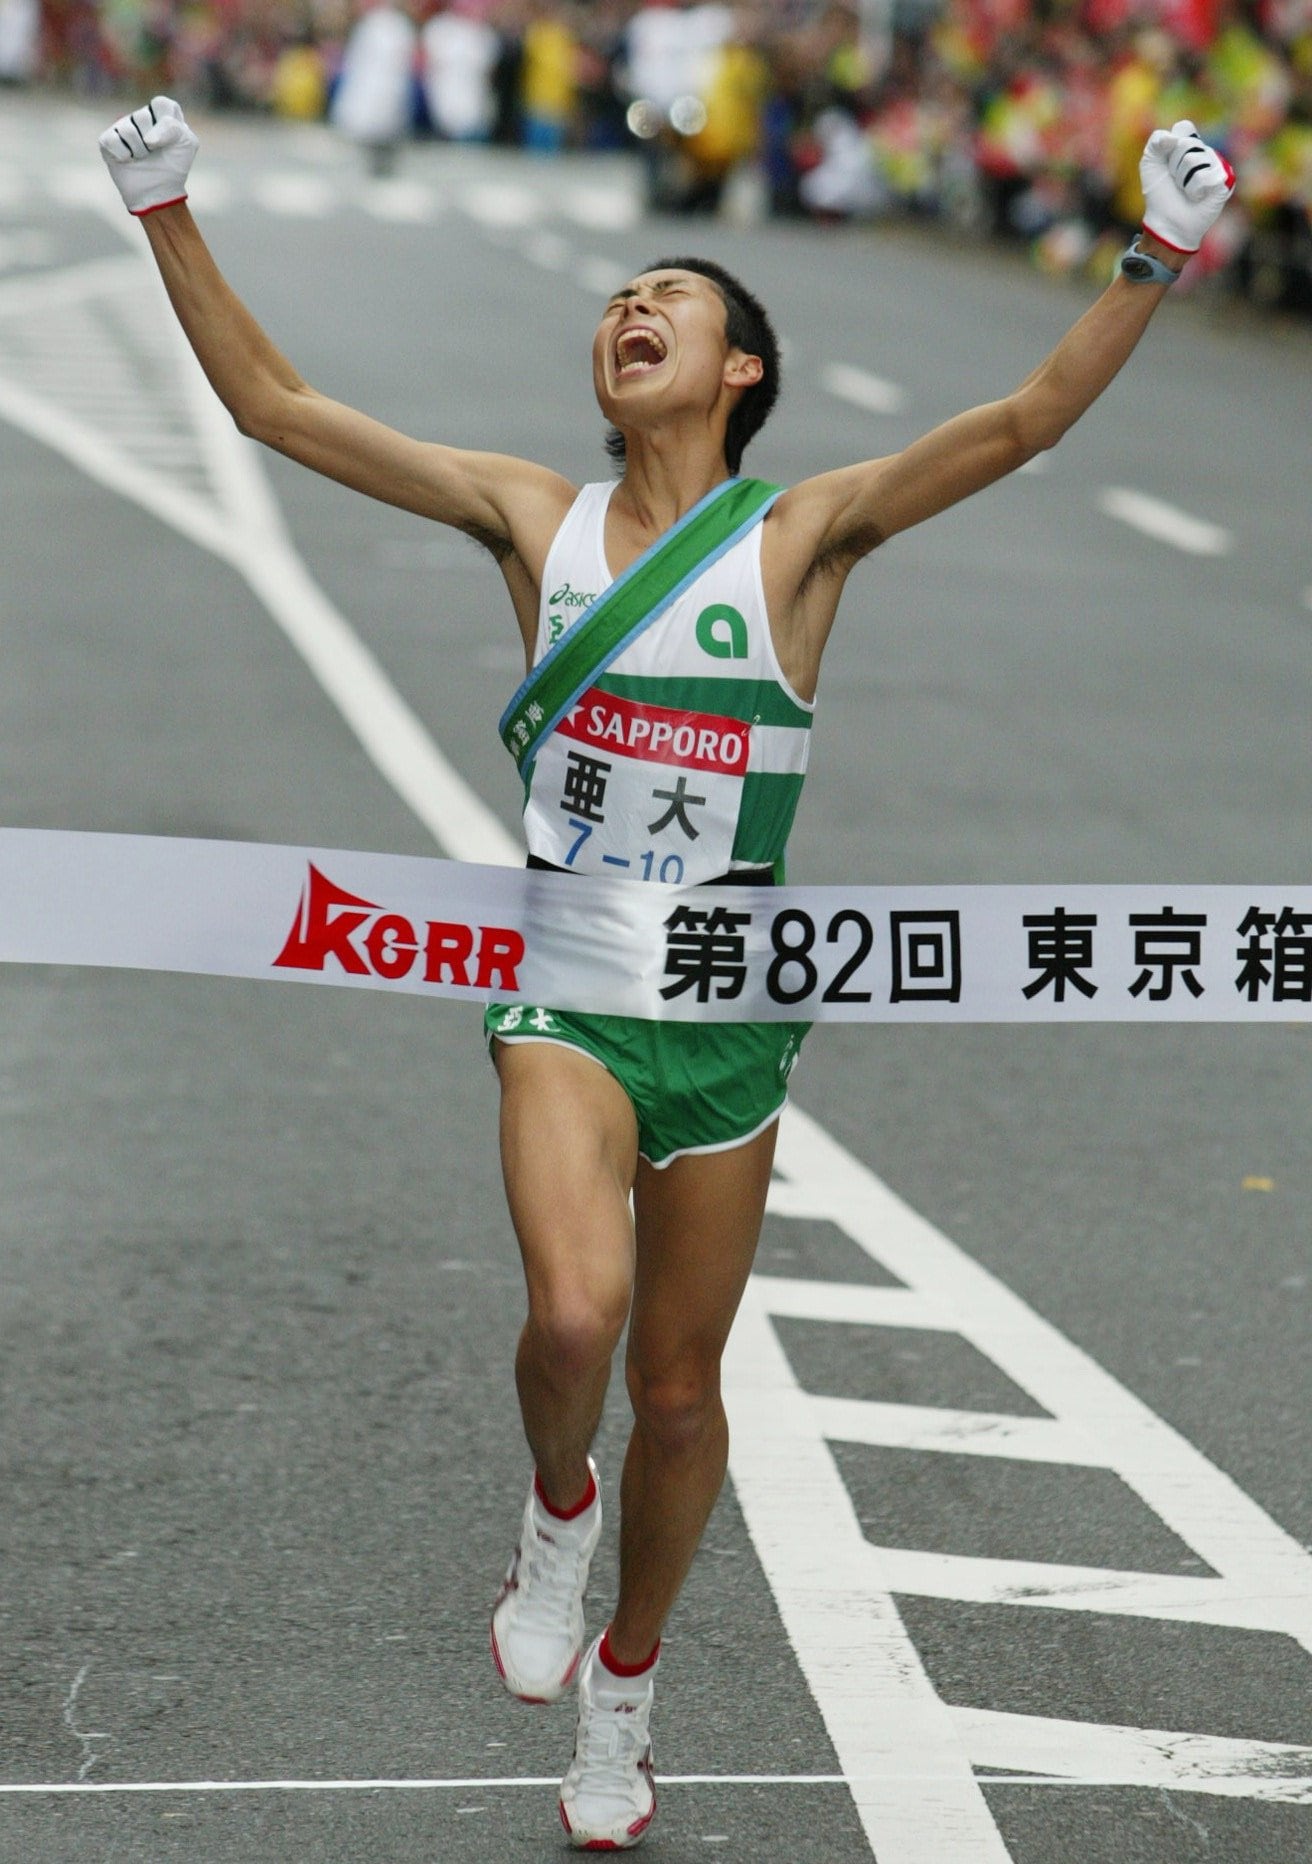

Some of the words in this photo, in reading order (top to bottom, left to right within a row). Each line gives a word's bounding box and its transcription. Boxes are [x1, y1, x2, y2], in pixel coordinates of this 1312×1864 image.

[586, 705, 742, 765] SAPPORO
[659, 904, 962, 1004] 第82回
[1021, 905, 1312, 1003] 東京箱
